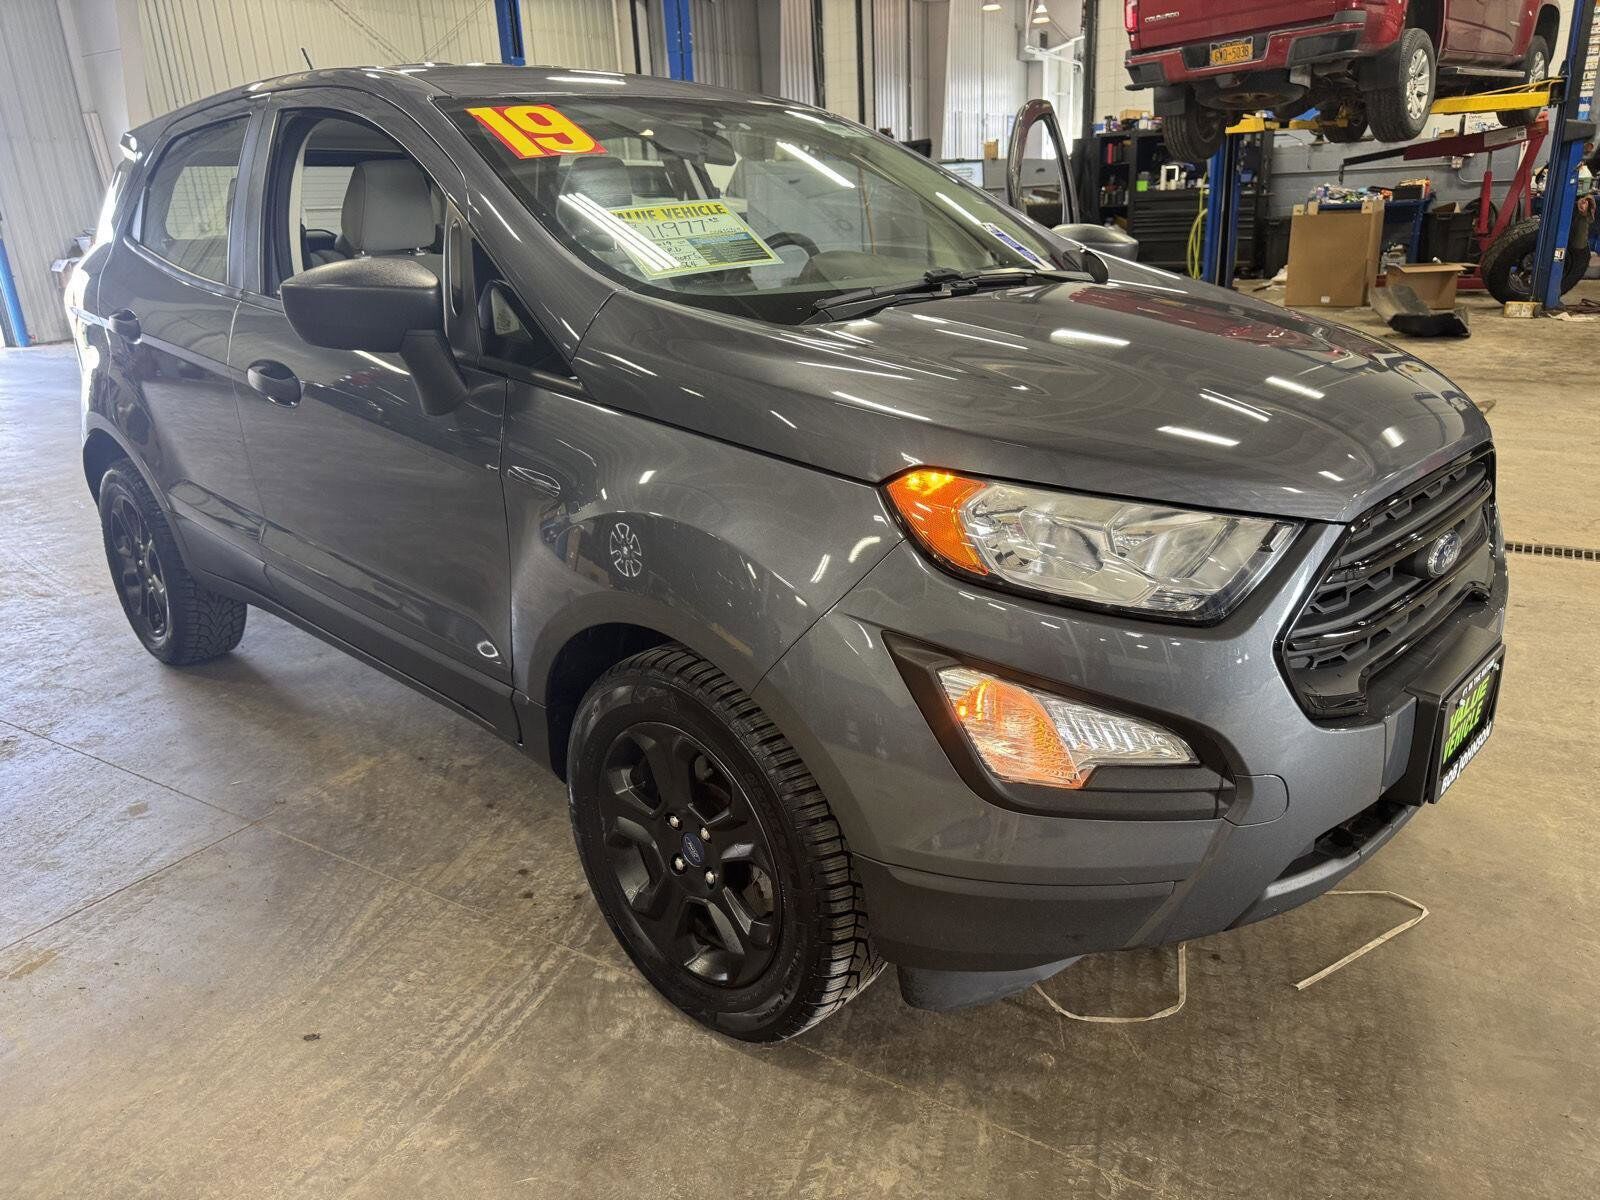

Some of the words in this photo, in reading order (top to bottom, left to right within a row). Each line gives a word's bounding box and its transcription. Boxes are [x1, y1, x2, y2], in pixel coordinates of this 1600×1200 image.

[466, 105, 595, 157] 19
[661, 204, 727, 219] VEHICLE
[1442, 698, 1484, 765] VEHICLE
[1448, 674, 1490, 736] VALUE
